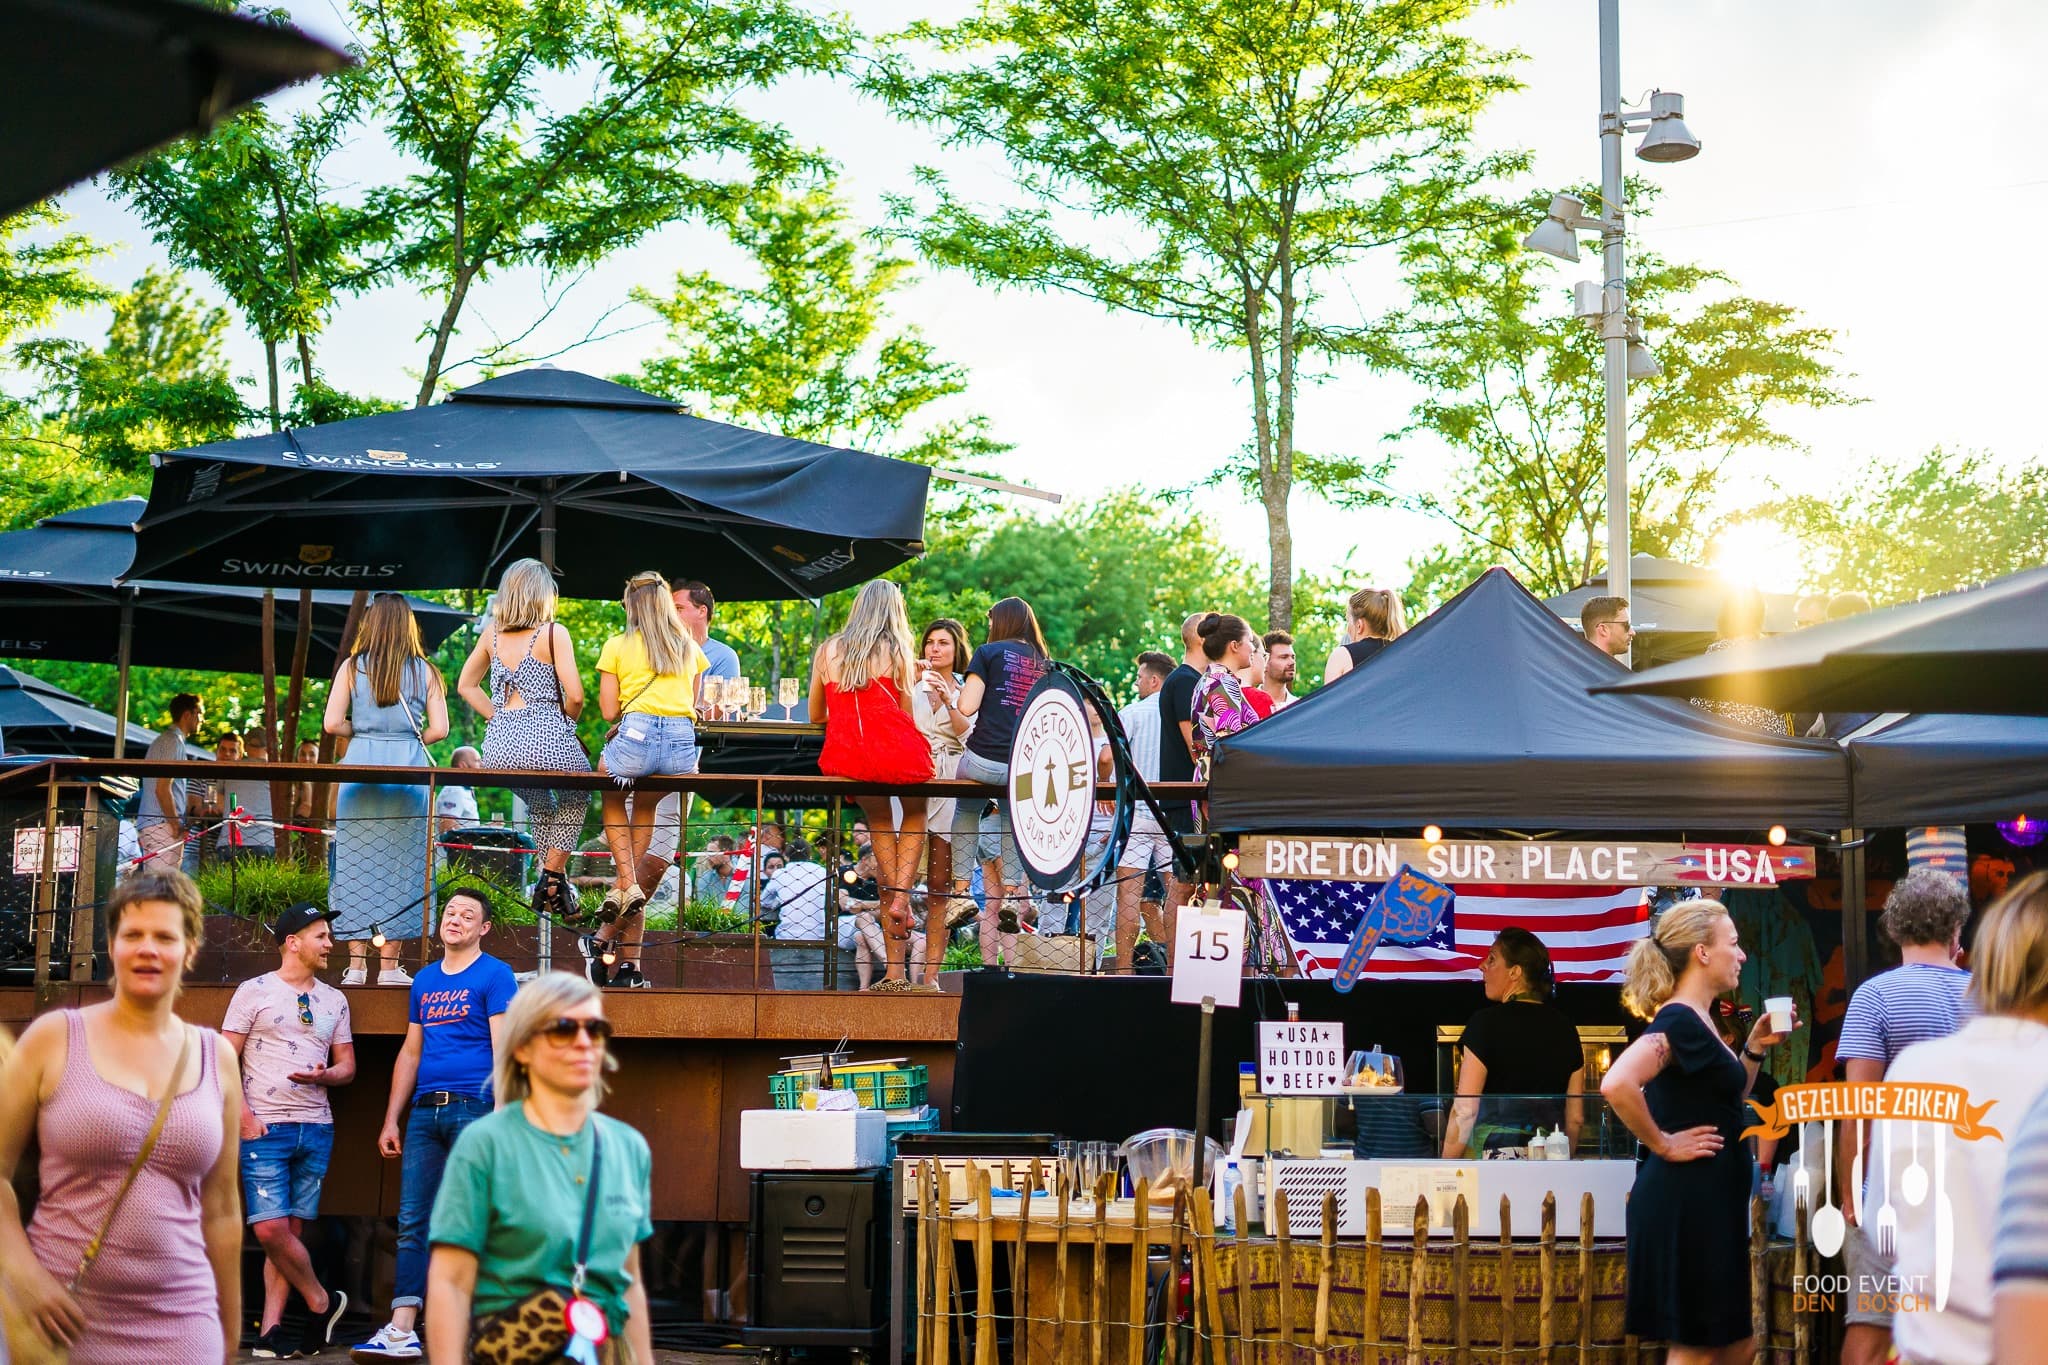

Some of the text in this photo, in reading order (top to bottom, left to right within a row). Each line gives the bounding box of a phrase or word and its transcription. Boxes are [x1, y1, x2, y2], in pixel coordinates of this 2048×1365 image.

[1024, 712, 1078, 763] BRETON
[1026, 806, 1078, 850] SUR PLACE
[1265, 840, 1776, 884] BRETON SUR PLACE USA
[1189, 930, 1229, 961] 15
[421, 988, 470, 1006] BISQUE
[426, 1003, 471, 1020] BALLS
[1288, 1027, 1318, 1043] USA
[1269, 1050, 1336, 1066] HOTDOG
[1283, 1073, 1324, 1089] BEEF
